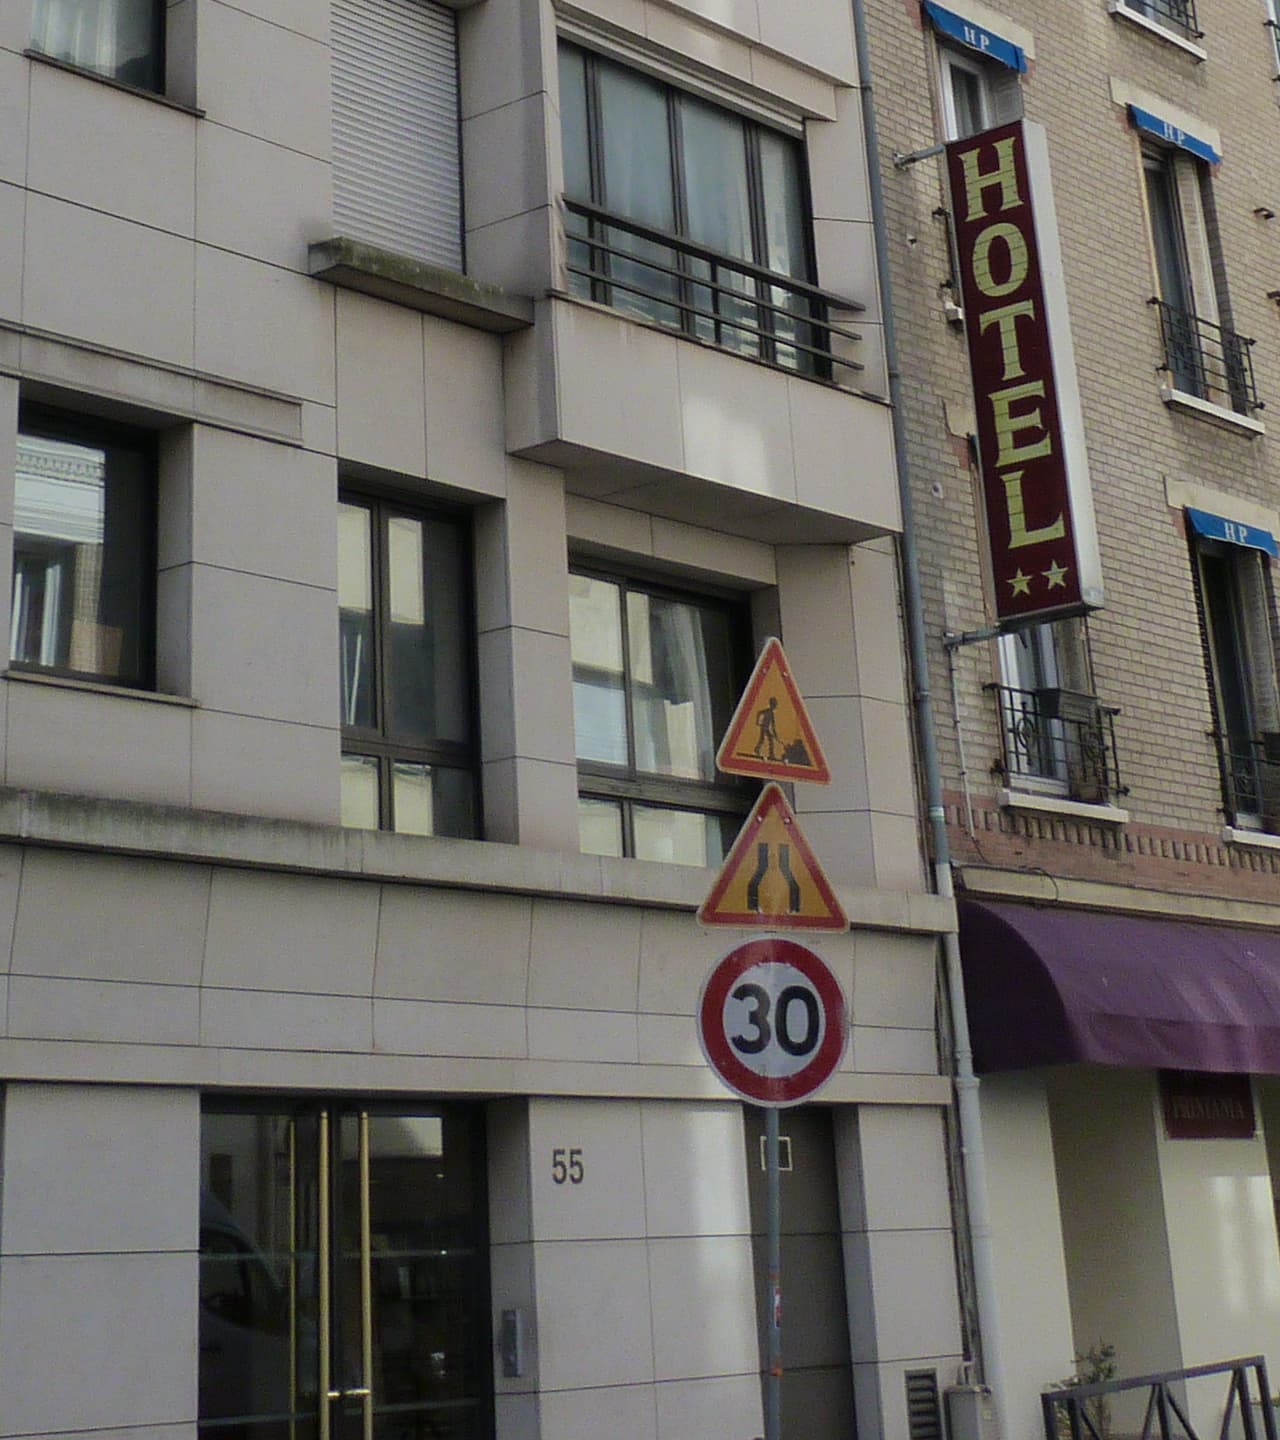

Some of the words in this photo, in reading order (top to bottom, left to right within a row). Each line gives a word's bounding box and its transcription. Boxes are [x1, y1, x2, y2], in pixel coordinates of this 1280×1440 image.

[957, 136, 1066, 550] HOTEL
[730, 983, 821, 1057] 30
[552, 1148, 584, 1185] 55
